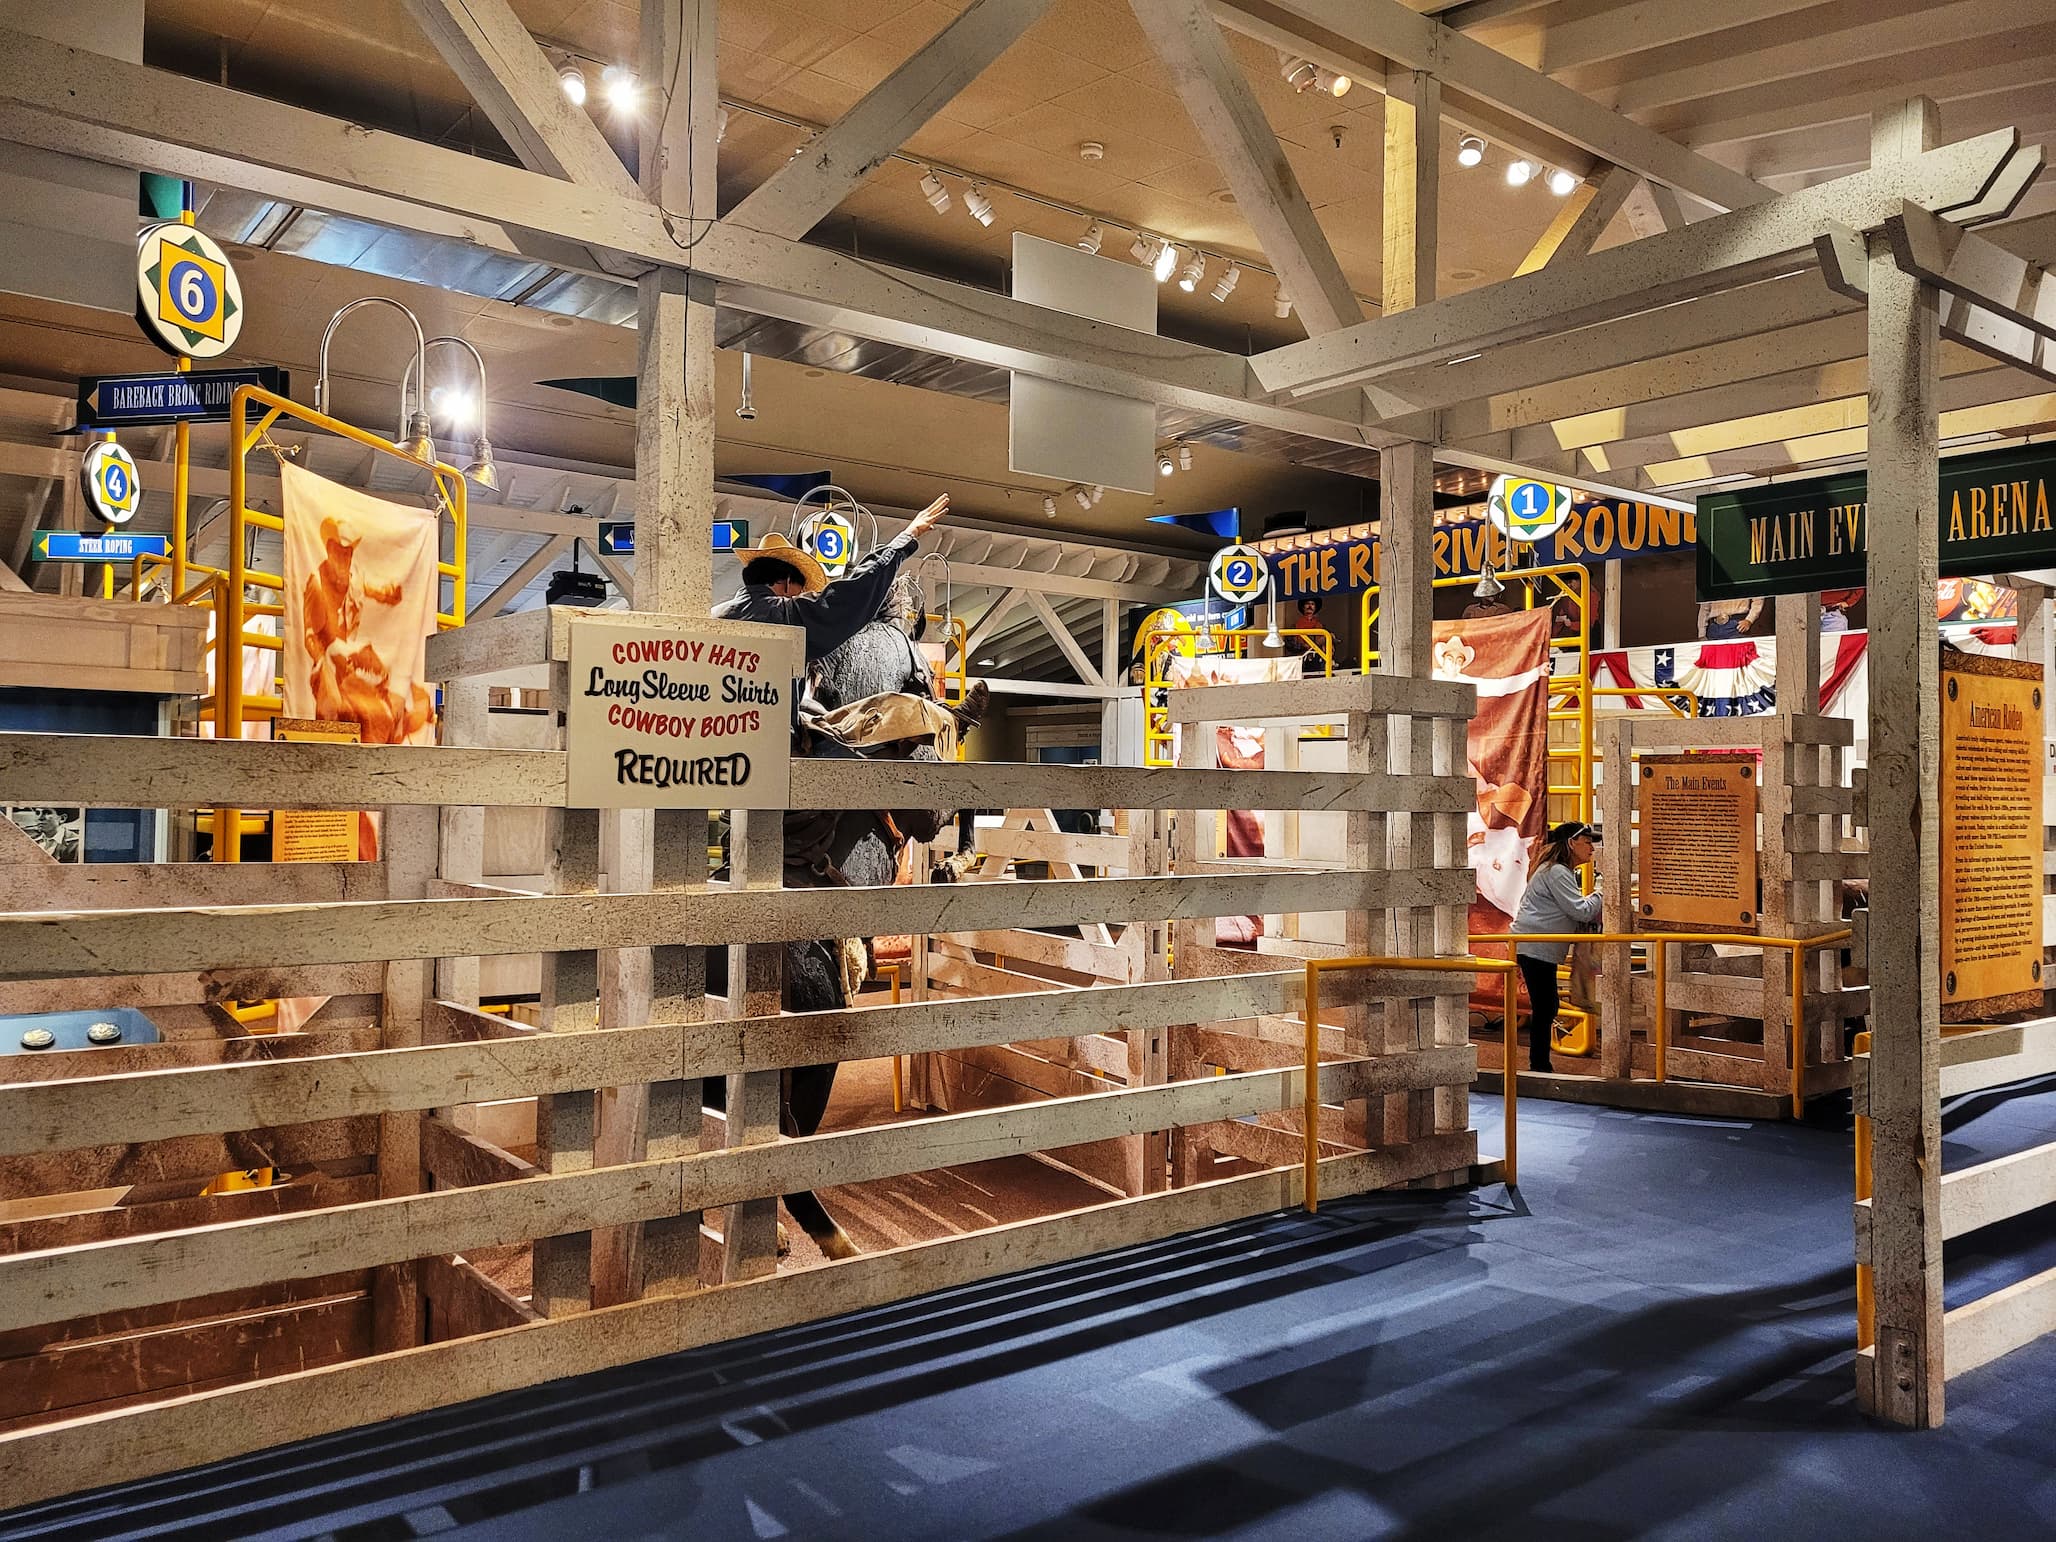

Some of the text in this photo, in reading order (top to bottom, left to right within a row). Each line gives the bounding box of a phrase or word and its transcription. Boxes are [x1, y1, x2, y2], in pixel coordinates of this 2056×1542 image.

[180, 271, 205, 316] 6
[113, 385, 165, 409] BAREBACK
[168, 382, 201, 407] BRONC
[108, 468, 123, 498] 4
[1521, 486, 1538, 515] 1
[1750, 510, 1816, 565] MAIN
[1947, 479, 2054, 542] ARENA
[105, 539, 133, 554] ROPING
[823, 532, 838, 557] 3
[1232, 562, 1247, 584] 2
[1278, 548, 1338, 596] THE
[612, 639, 761, 673] COWBOY HATS
[721, 674, 779, 706] Shirts
[608, 703, 760, 739] COWBOY BOOTS
[1969, 700, 2001, 729] American
[614, 749, 750, 788] REQUIRED
[1665, 776, 1727, 790] The Main Events
